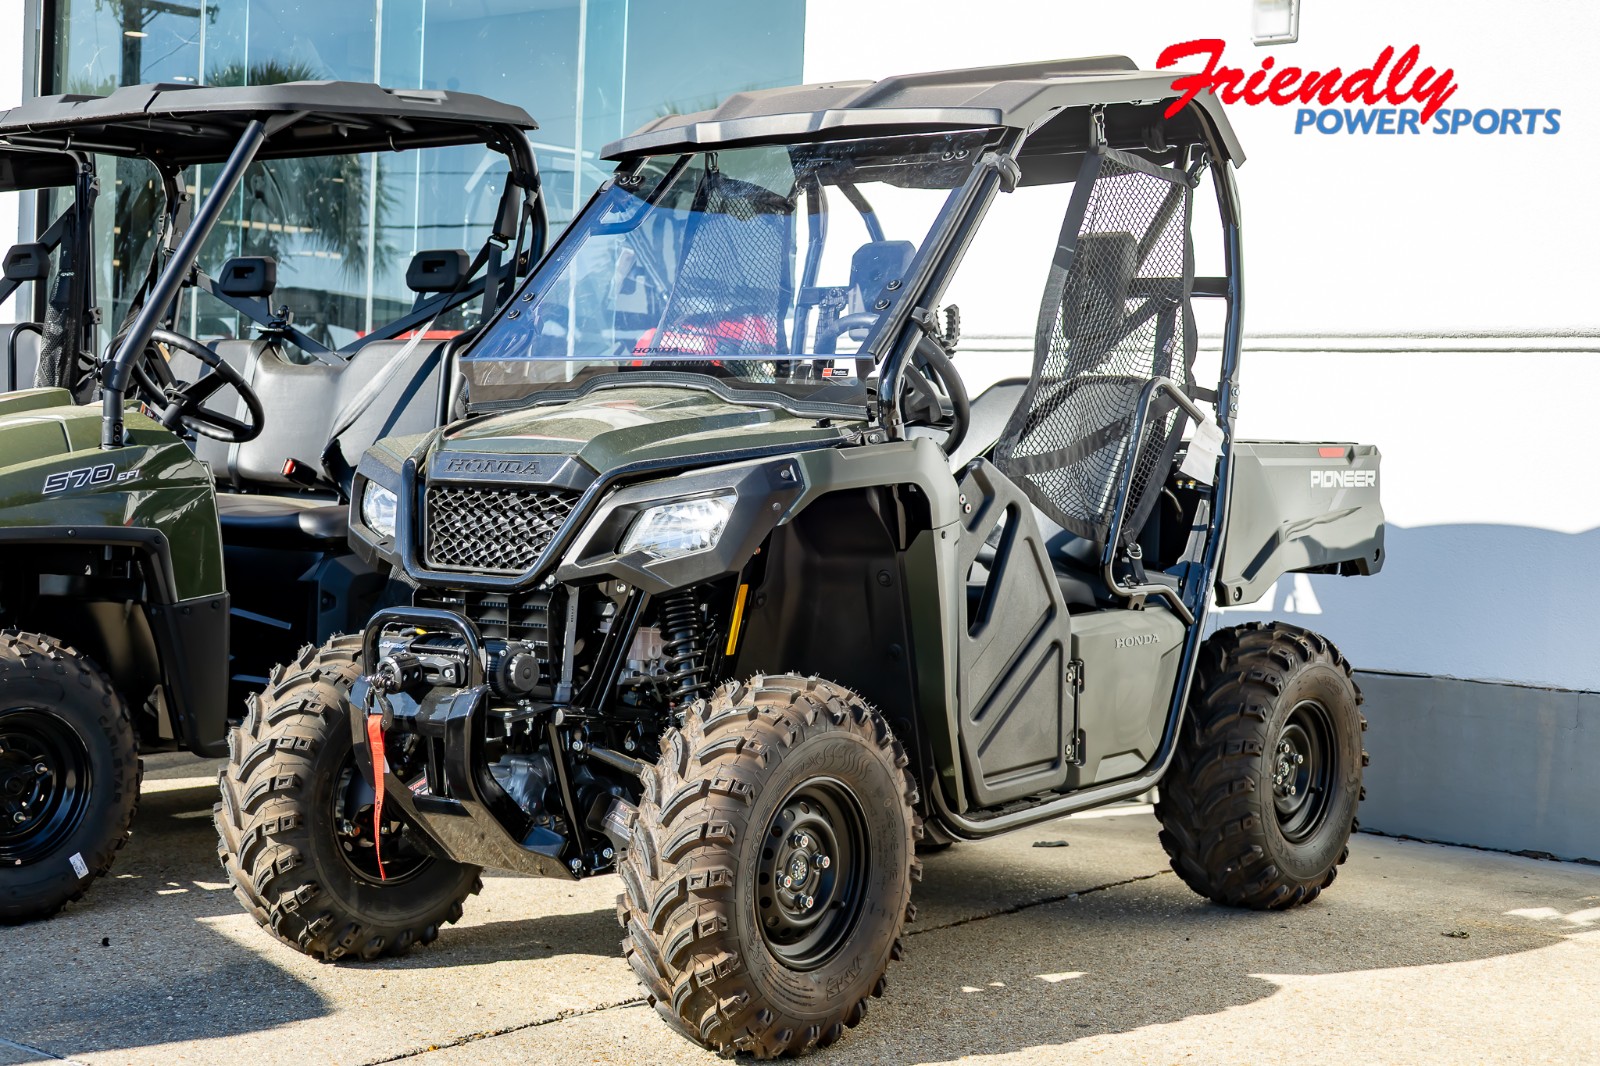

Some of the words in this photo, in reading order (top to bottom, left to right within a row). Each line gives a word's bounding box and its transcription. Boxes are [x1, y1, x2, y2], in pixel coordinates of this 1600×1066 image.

[444, 459, 543, 475] HONDA
[42, 463, 115, 494] 570
[116, 469, 140, 481] EFI
[1310, 470, 1376, 488] PIONEER
[1115, 634, 1160, 648] HONDA
